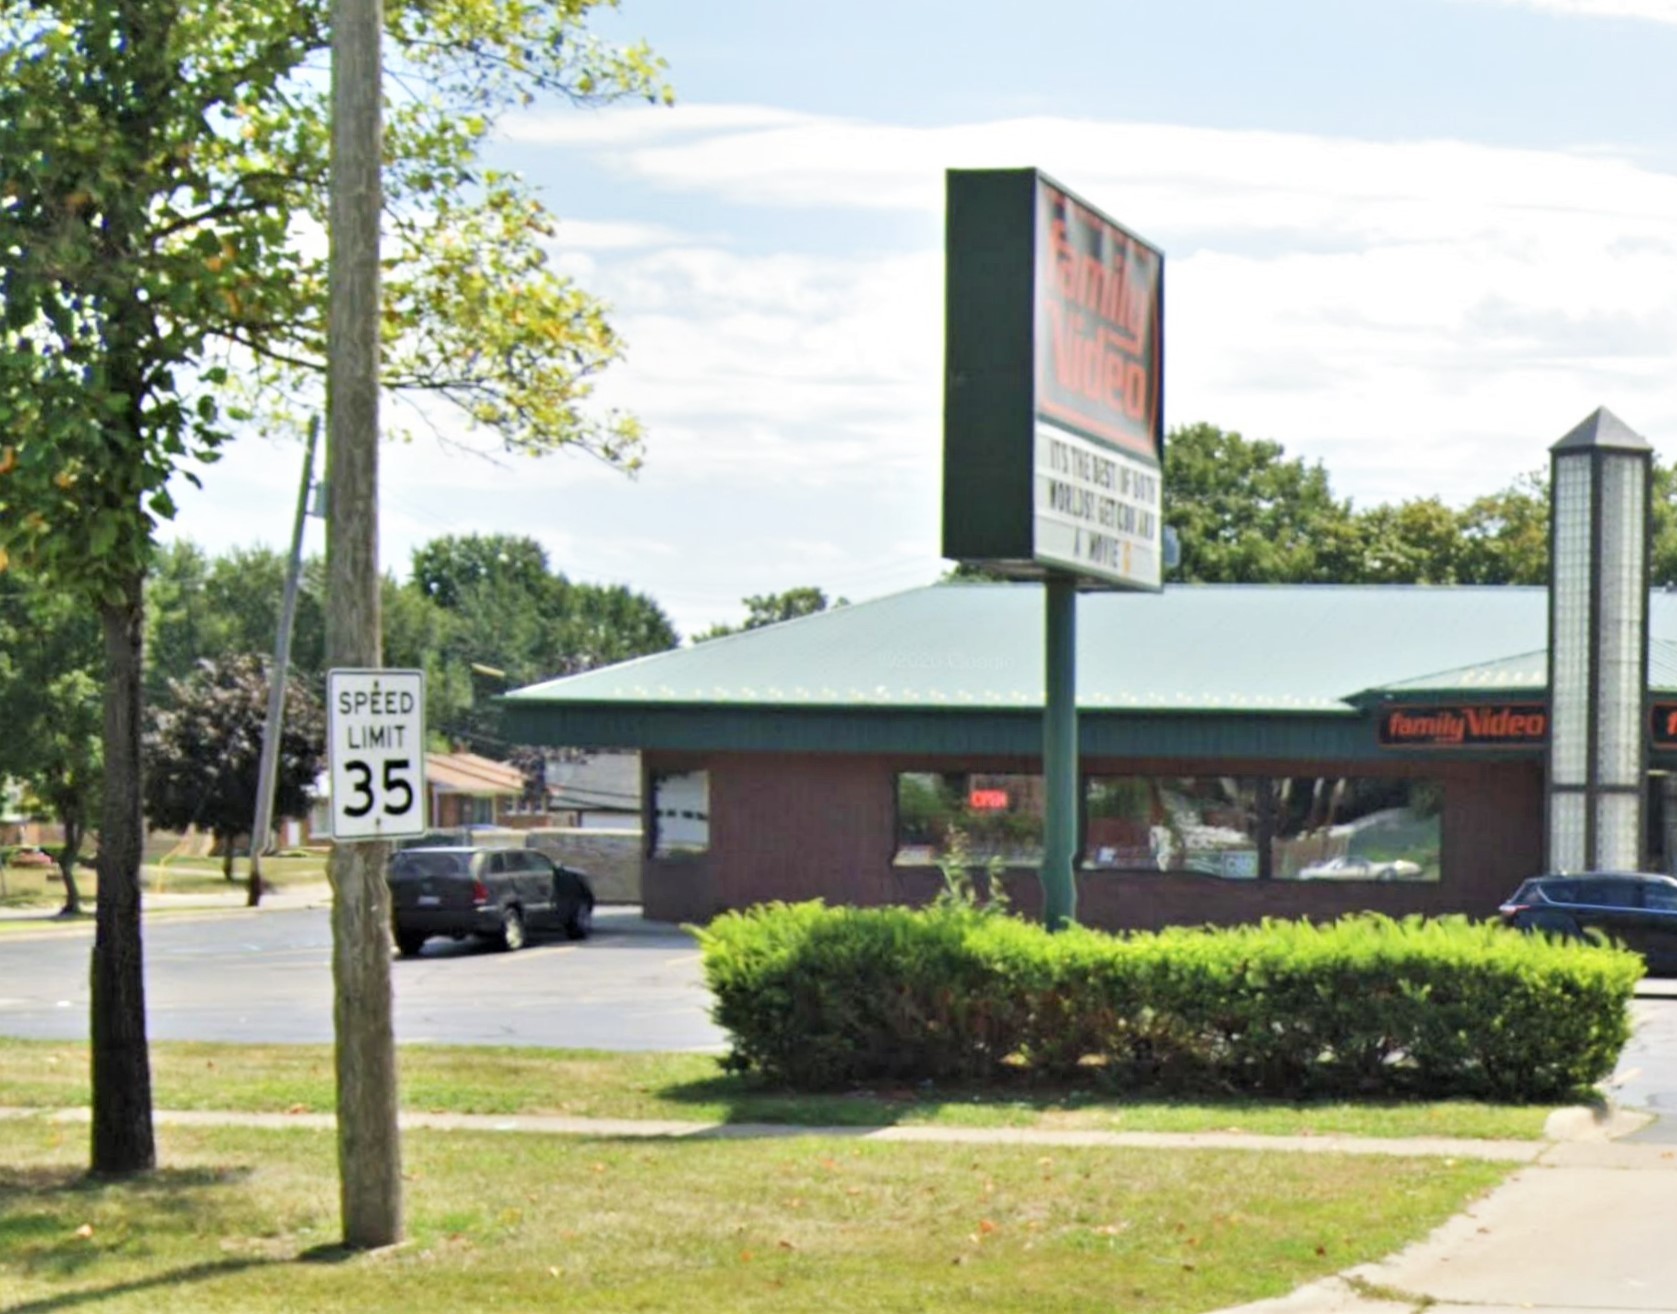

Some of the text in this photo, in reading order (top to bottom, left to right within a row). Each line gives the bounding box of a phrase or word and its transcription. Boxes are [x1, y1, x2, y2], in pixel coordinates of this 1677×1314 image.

[1050, 217, 1147, 356] family
[1046, 298, 1147, 421] Video
[1072, 446, 1090, 482] THE
[1093, 455, 1115, 491] BEST
[339, 692, 414, 715] SPEED
[1389, 706, 1546, 744] family Video
[348, 726, 405, 749] LIMIT
[343, 759, 414, 817] 35
